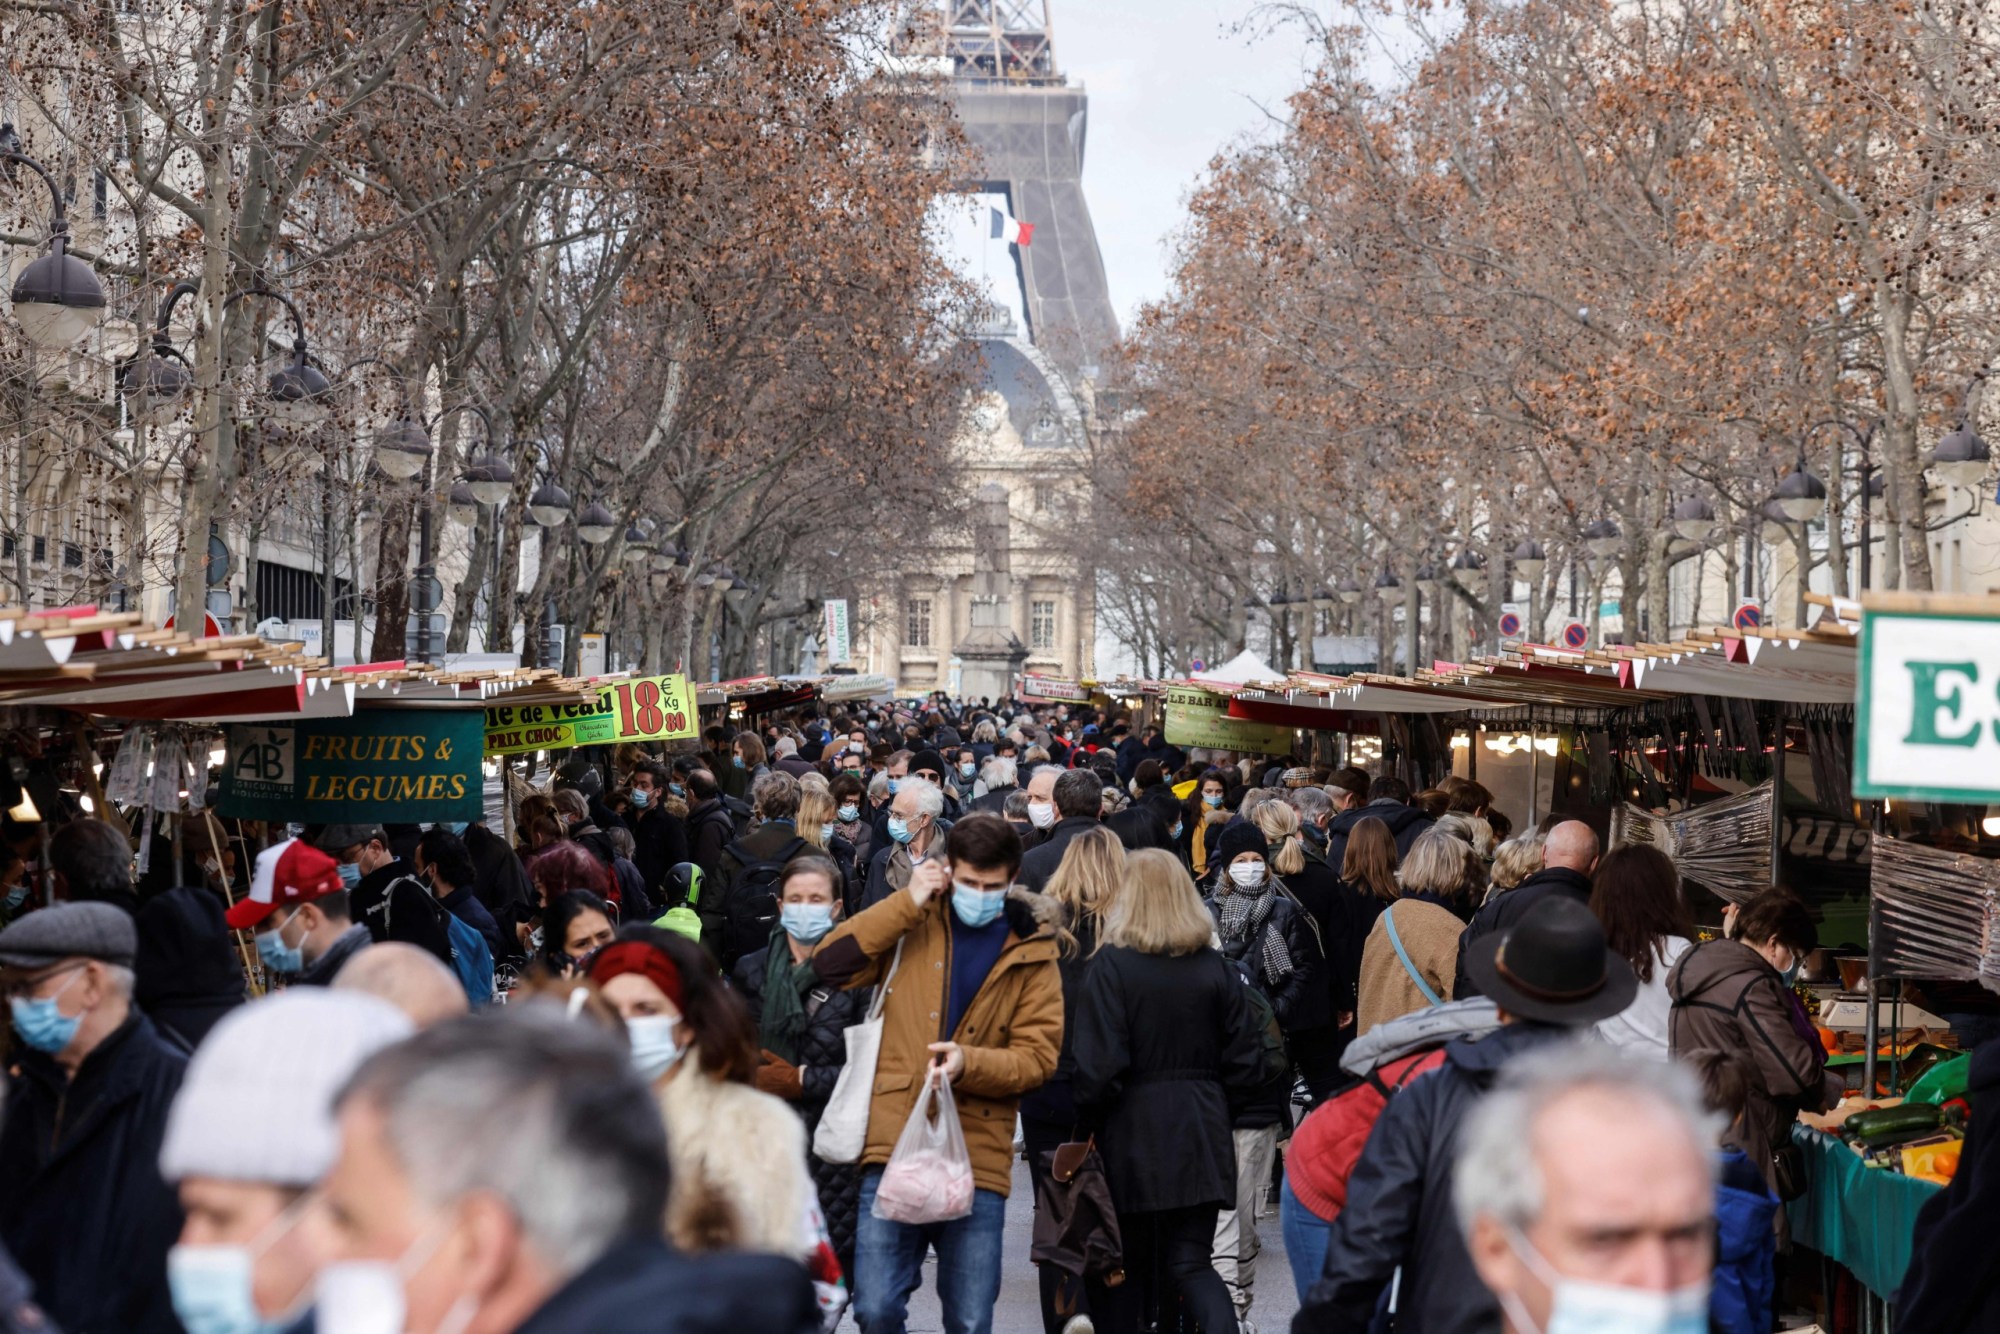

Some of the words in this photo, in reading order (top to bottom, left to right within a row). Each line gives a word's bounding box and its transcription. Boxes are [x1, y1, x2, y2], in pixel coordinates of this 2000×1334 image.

[836, 603, 847, 660] AUVERGNE
[615, 680, 664, 737] 18
[660, 677, 672, 695] €
[664, 696, 679, 710] Kg
[1170, 694, 1186, 704] LE
[1187, 696, 1213, 707] BAR
[1903, 661, 2000, 747] E
[520, 705, 544, 724] de
[665, 712, 686, 732] 80
[302, 735, 426, 761] FRUITS
[434, 737, 453, 760] &
[488, 733, 521, 749] PRIX
[525, 726, 562, 744] CHOC
[236, 743, 284, 780] AB
[304, 774, 467, 802] LEGUMES
